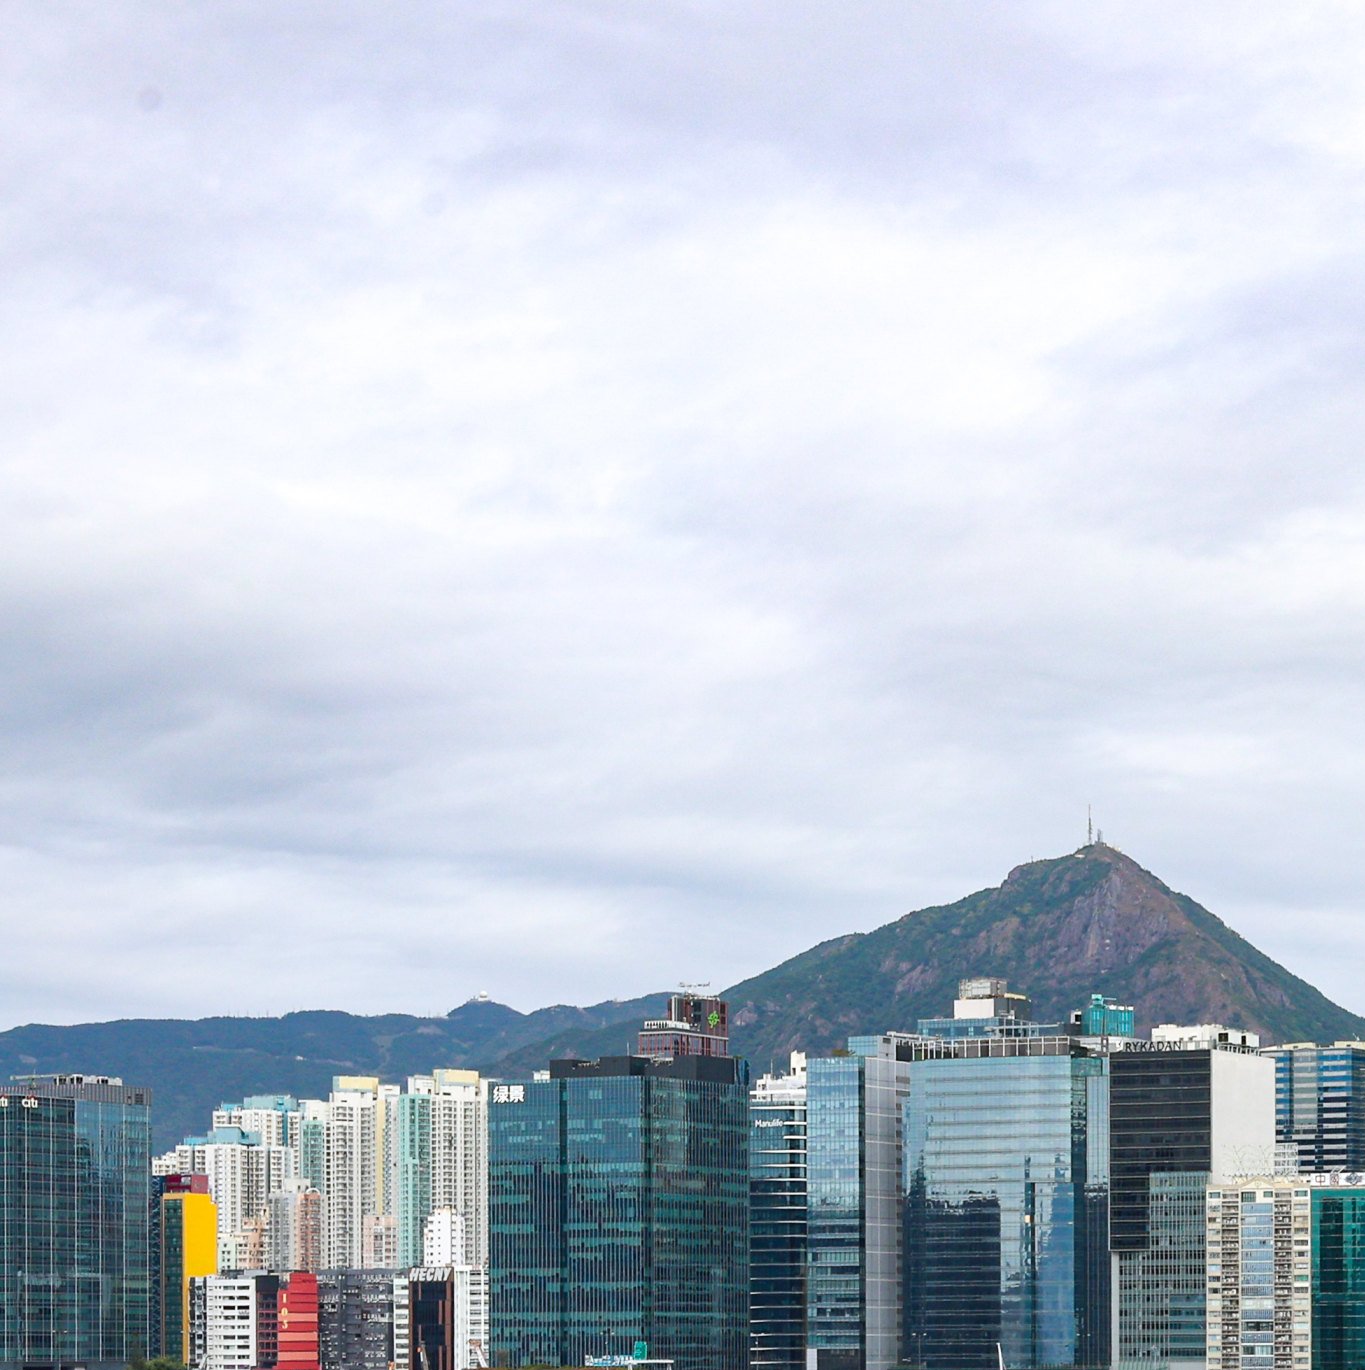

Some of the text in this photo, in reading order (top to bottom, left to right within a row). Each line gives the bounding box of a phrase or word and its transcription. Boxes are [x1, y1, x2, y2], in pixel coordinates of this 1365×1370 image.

[1125, 1041, 1182, 1053] RYKADAN
[755, 1119, 784, 1128] Manulife
[409, 1267, 452, 1282] HECNY
